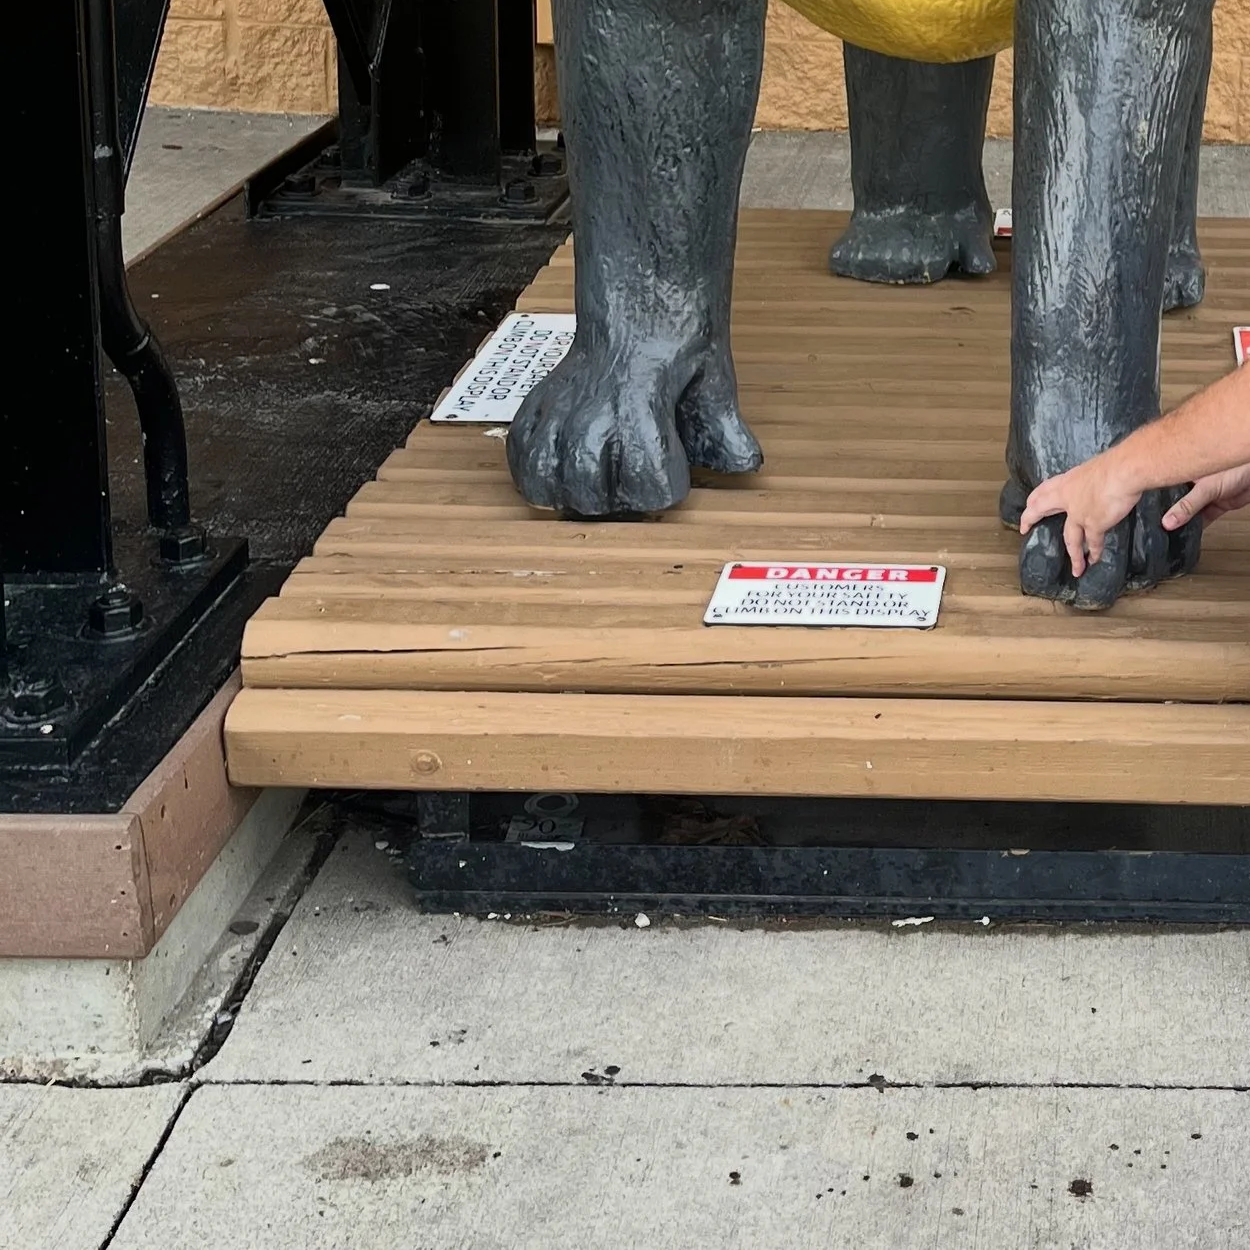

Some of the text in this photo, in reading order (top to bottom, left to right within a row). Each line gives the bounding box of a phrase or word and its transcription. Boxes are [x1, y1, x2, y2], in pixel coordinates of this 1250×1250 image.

[452, 321, 534, 411] CLIMB ON THIS DISPLAY
[486, 330, 552, 400] DO NOT STAND OR
[765, 567, 909, 581] DANGER
[774, 583, 885, 591] CUSTOMERS
[747, 590, 909, 600] FOR YOUR SAFETY
[741, 598, 769, 606] DO
[774, 599, 811, 607] NOT
[883, 600, 909, 608] OR
[713, 606, 932, 617] CLIMB ON THIS DISPLAY
